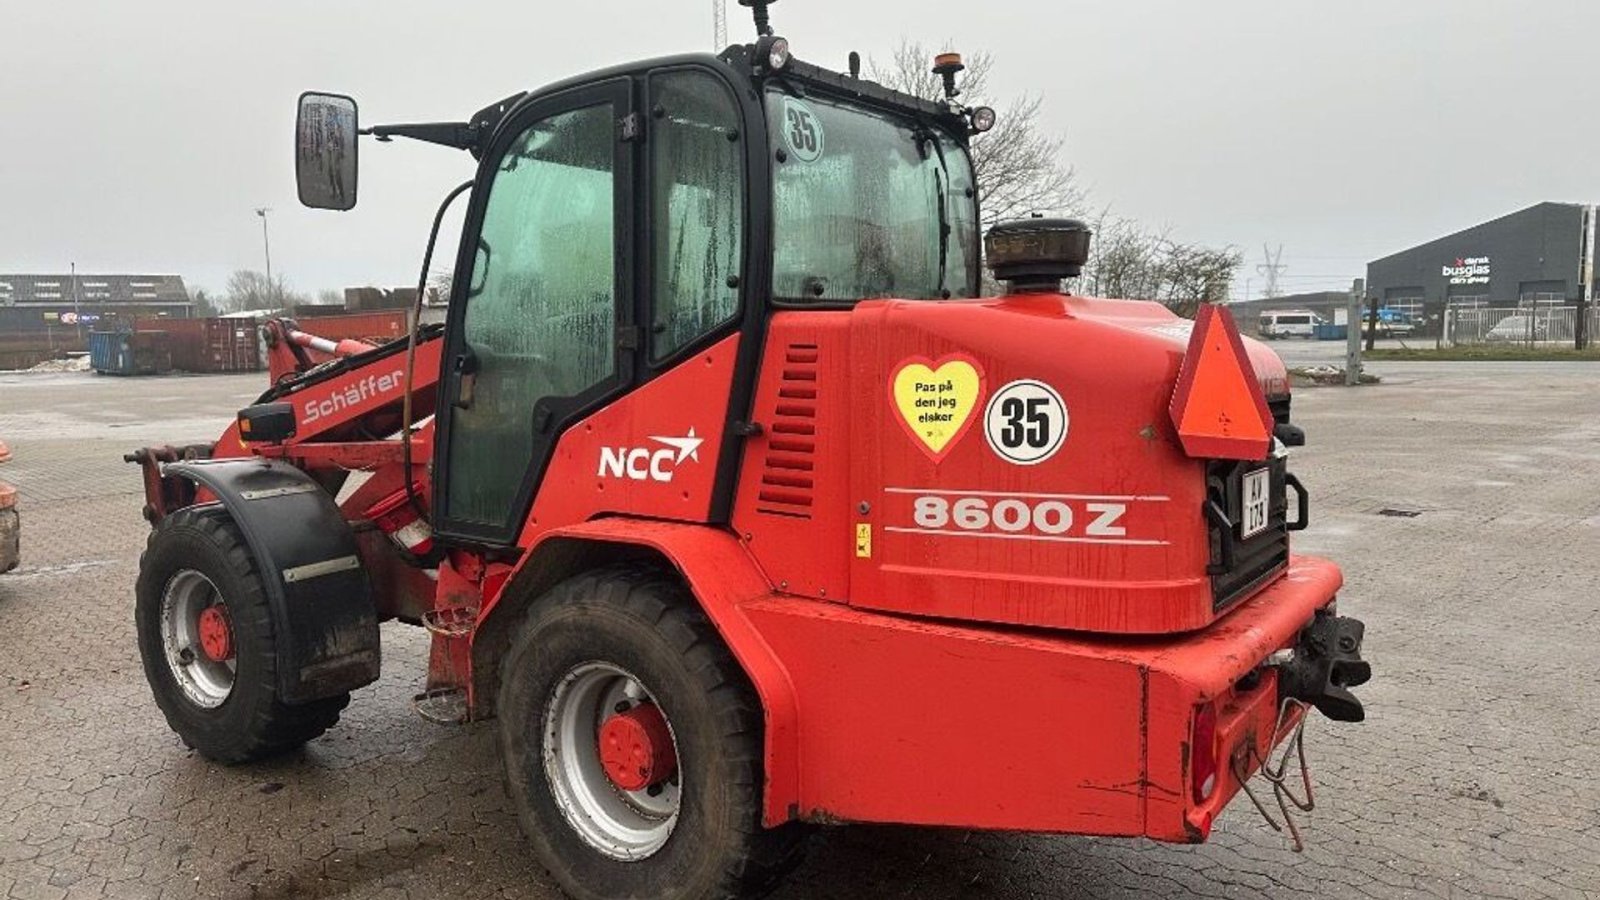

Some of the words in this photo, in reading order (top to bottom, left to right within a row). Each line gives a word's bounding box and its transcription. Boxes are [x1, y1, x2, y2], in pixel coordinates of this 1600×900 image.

[786, 107, 817, 153] 35
[1442, 264, 1490, 277] busglas
[303, 370, 404, 424] Schäffer
[915, 383, 936, 393] Pas
[938, 380, 953, 393] på
[915, 398, 936, 407] den
[937, 397, 956, 409] jeg
[918, 412, 954, 423] elsker
[1001, 397, 1050, 448] 35
[597, 446, 675, 482] NCC
[912, 495, 1073, 535] 8600
[1085, 503, 1127, 536] Z
